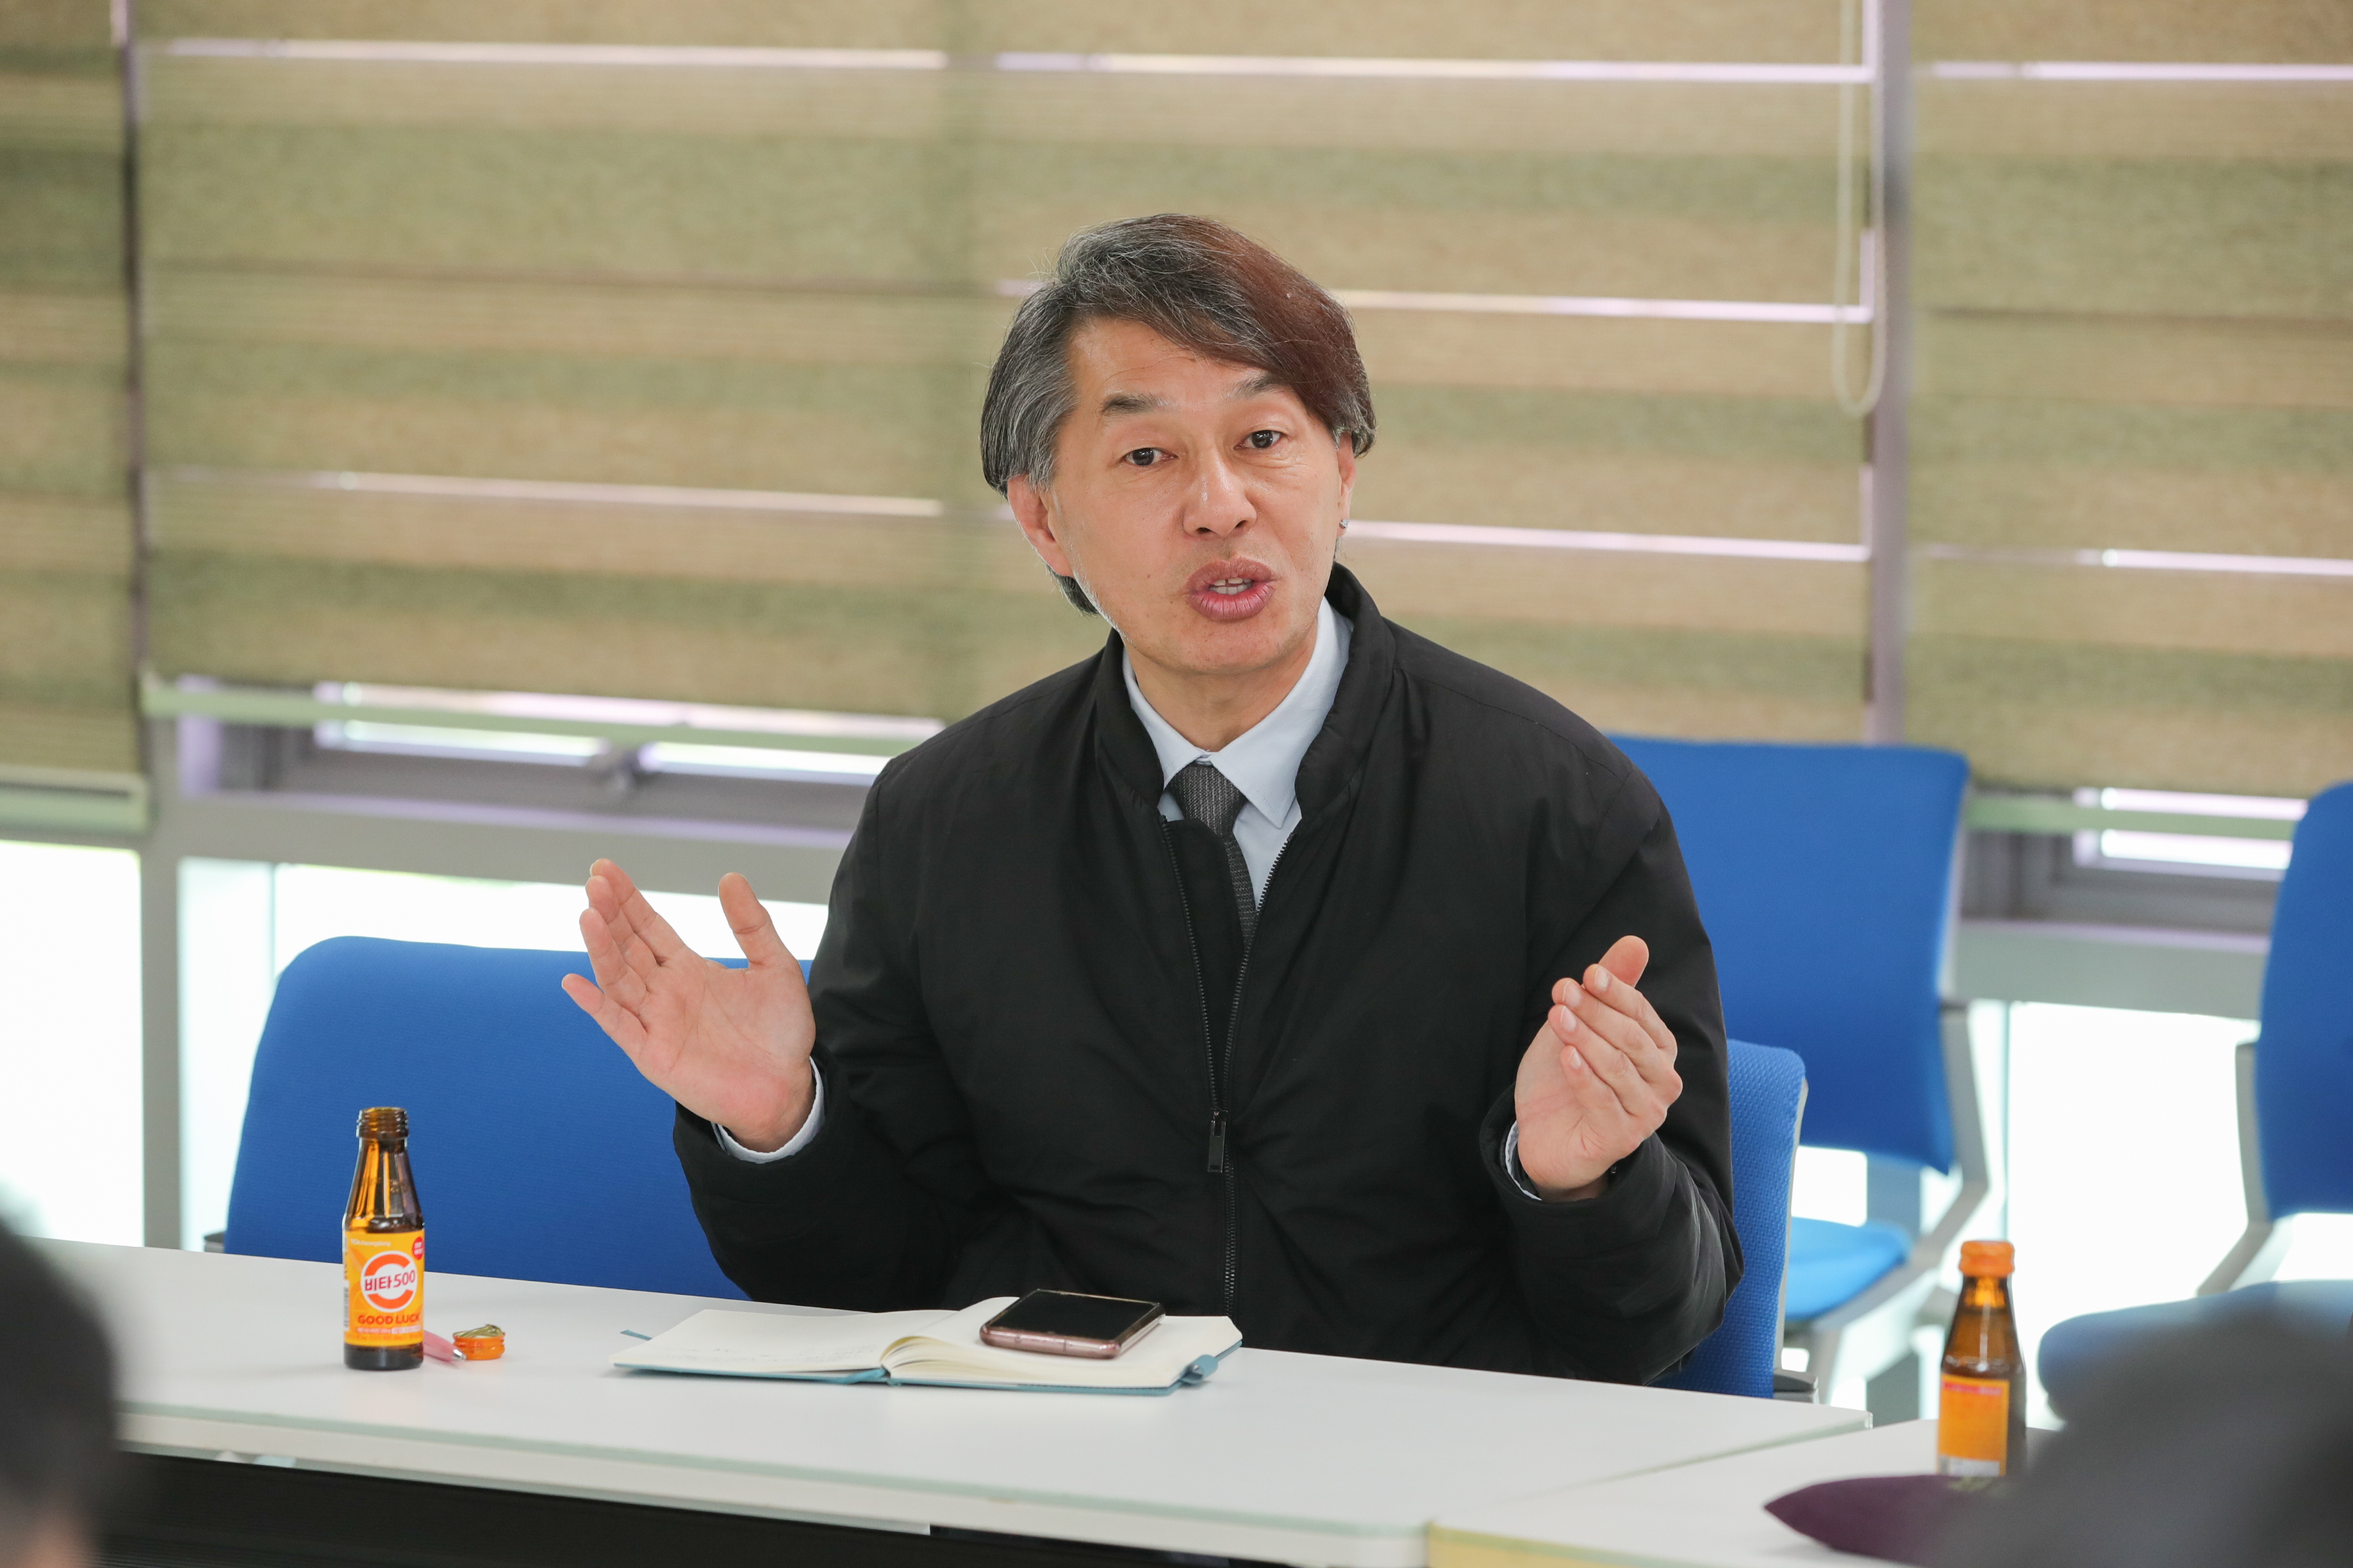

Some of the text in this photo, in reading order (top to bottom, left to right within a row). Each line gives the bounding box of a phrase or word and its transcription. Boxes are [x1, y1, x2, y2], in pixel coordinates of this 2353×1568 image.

[365, 1269, 415, 1291] 비타500
[358, 1313, 420, 1325] GOOD LUCK
